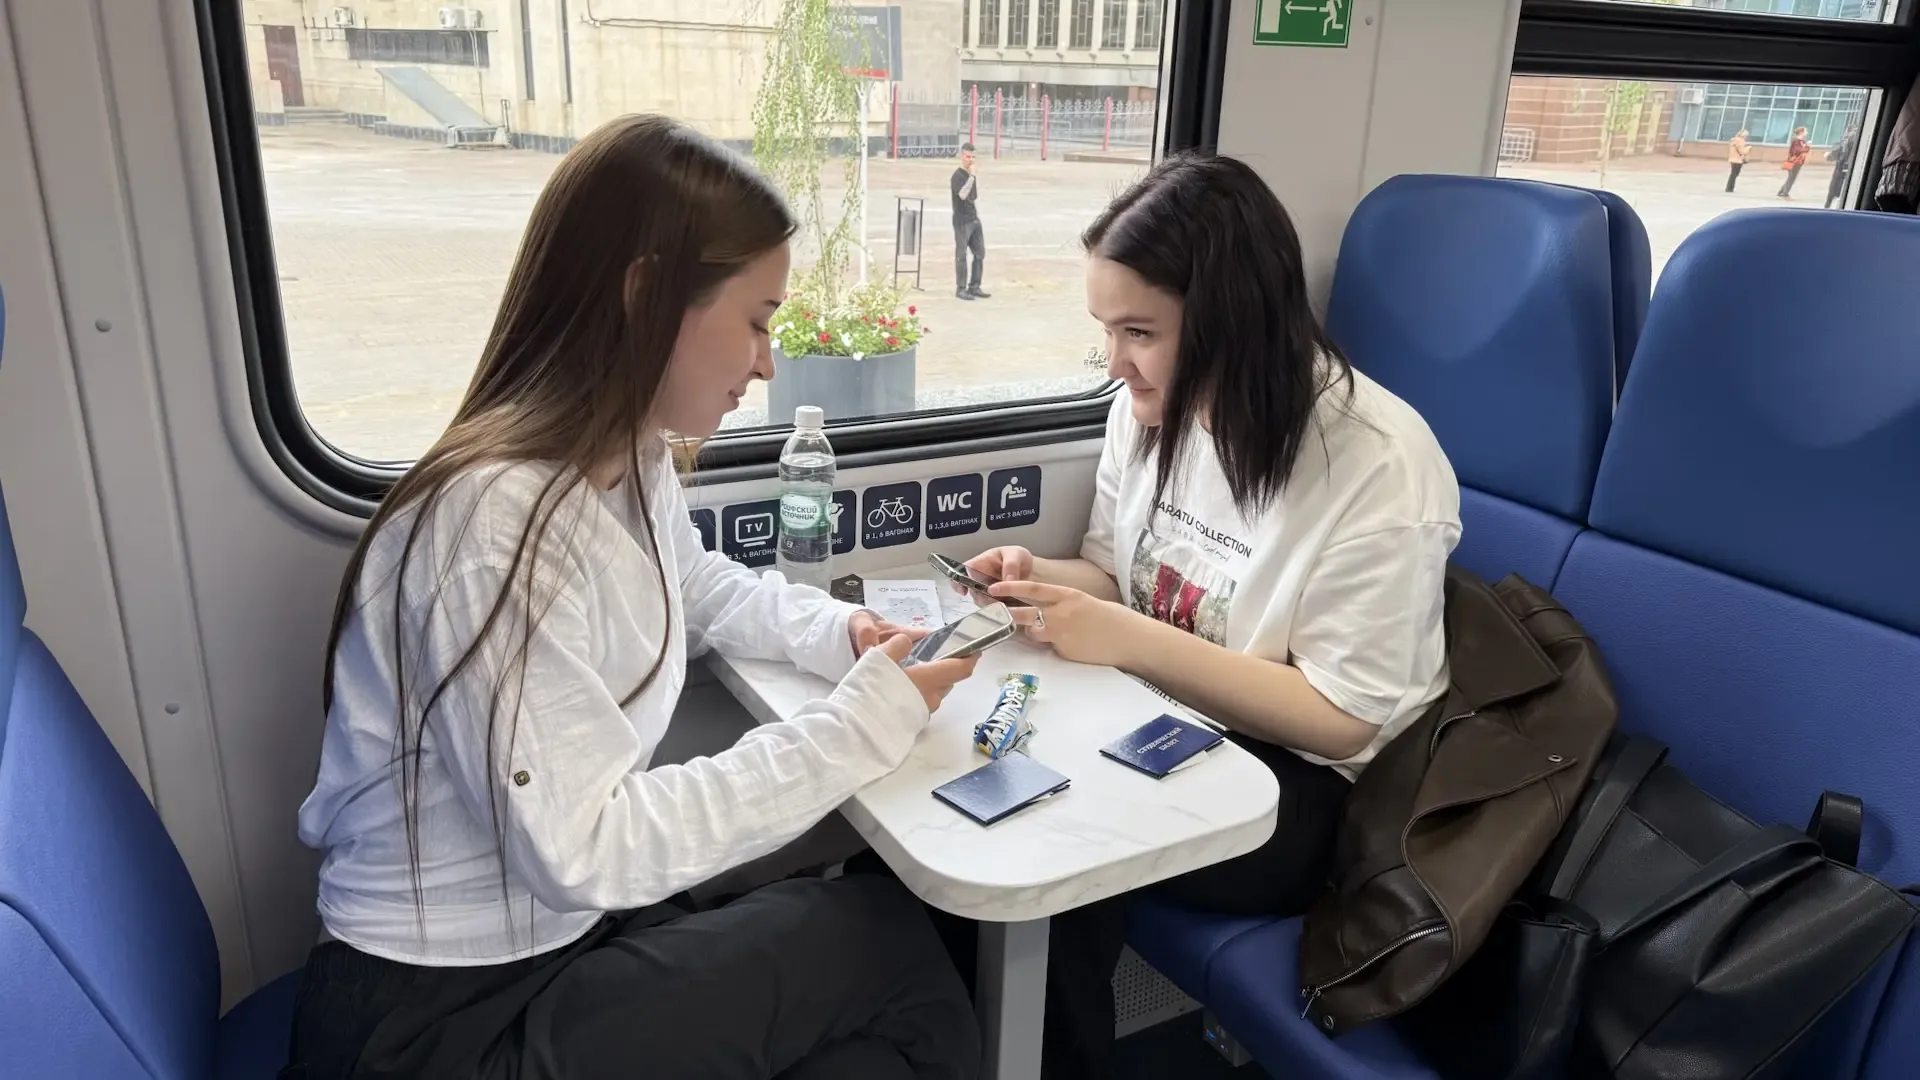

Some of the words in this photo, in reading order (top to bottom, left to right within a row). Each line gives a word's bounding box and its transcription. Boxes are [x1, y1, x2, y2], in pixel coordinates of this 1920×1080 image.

[936, 491, 972, 513] WC
[995, 512, 1006, 520] WC
[1012, 508, 1036, 518] ВАГОНА
[745, 522, 764, 534] TV
[928, 523, 933, 531] В
[950, 516, 979, 528] ВАГОНАХ
[1157, 501, 1195, 526] ARATU
[1196, 521, 1252, 558] COLLECTION
[885, 526, 915, 538] ВАГОНАХ
[749, 547, 777, 558] ВАГОНА
